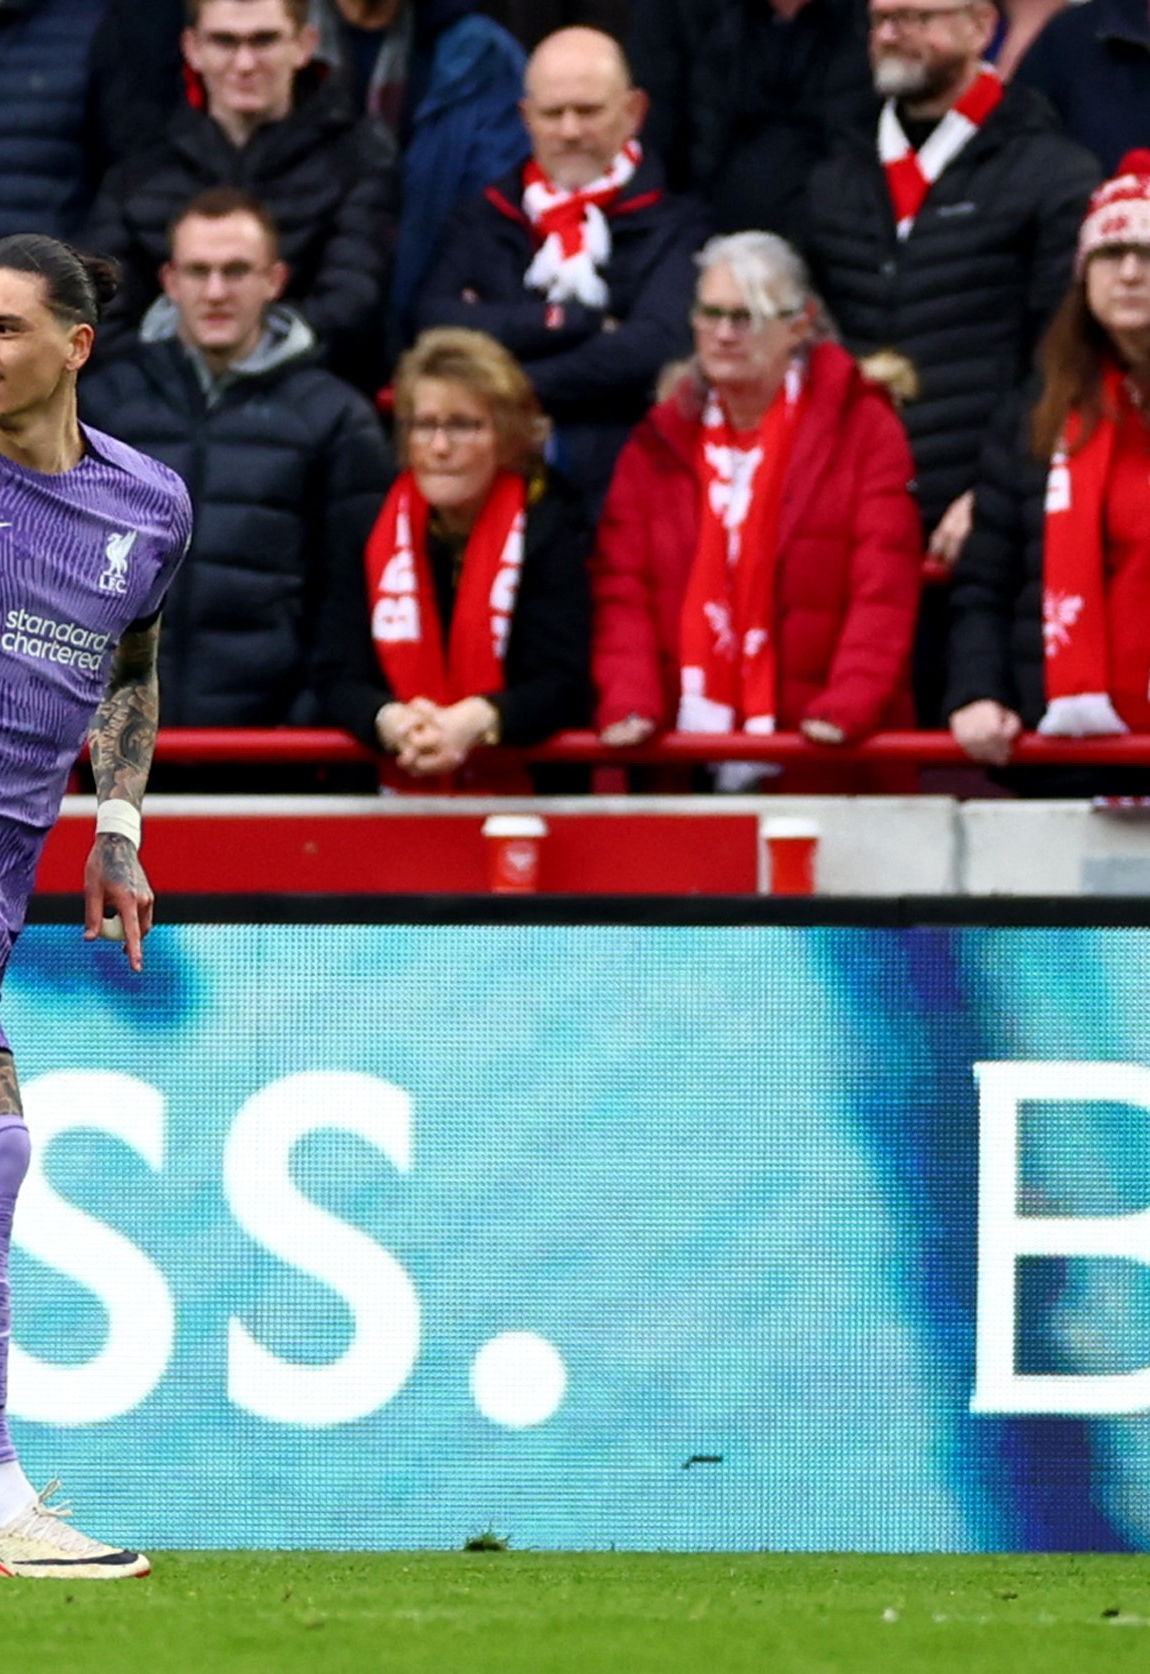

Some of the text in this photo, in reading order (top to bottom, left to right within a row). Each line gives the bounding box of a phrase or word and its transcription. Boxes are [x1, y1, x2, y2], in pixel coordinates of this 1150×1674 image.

[99, 573, 127, 594] LFC
[6, 609, 111, 651] standard
[1, 631, 105, 670] chartered
